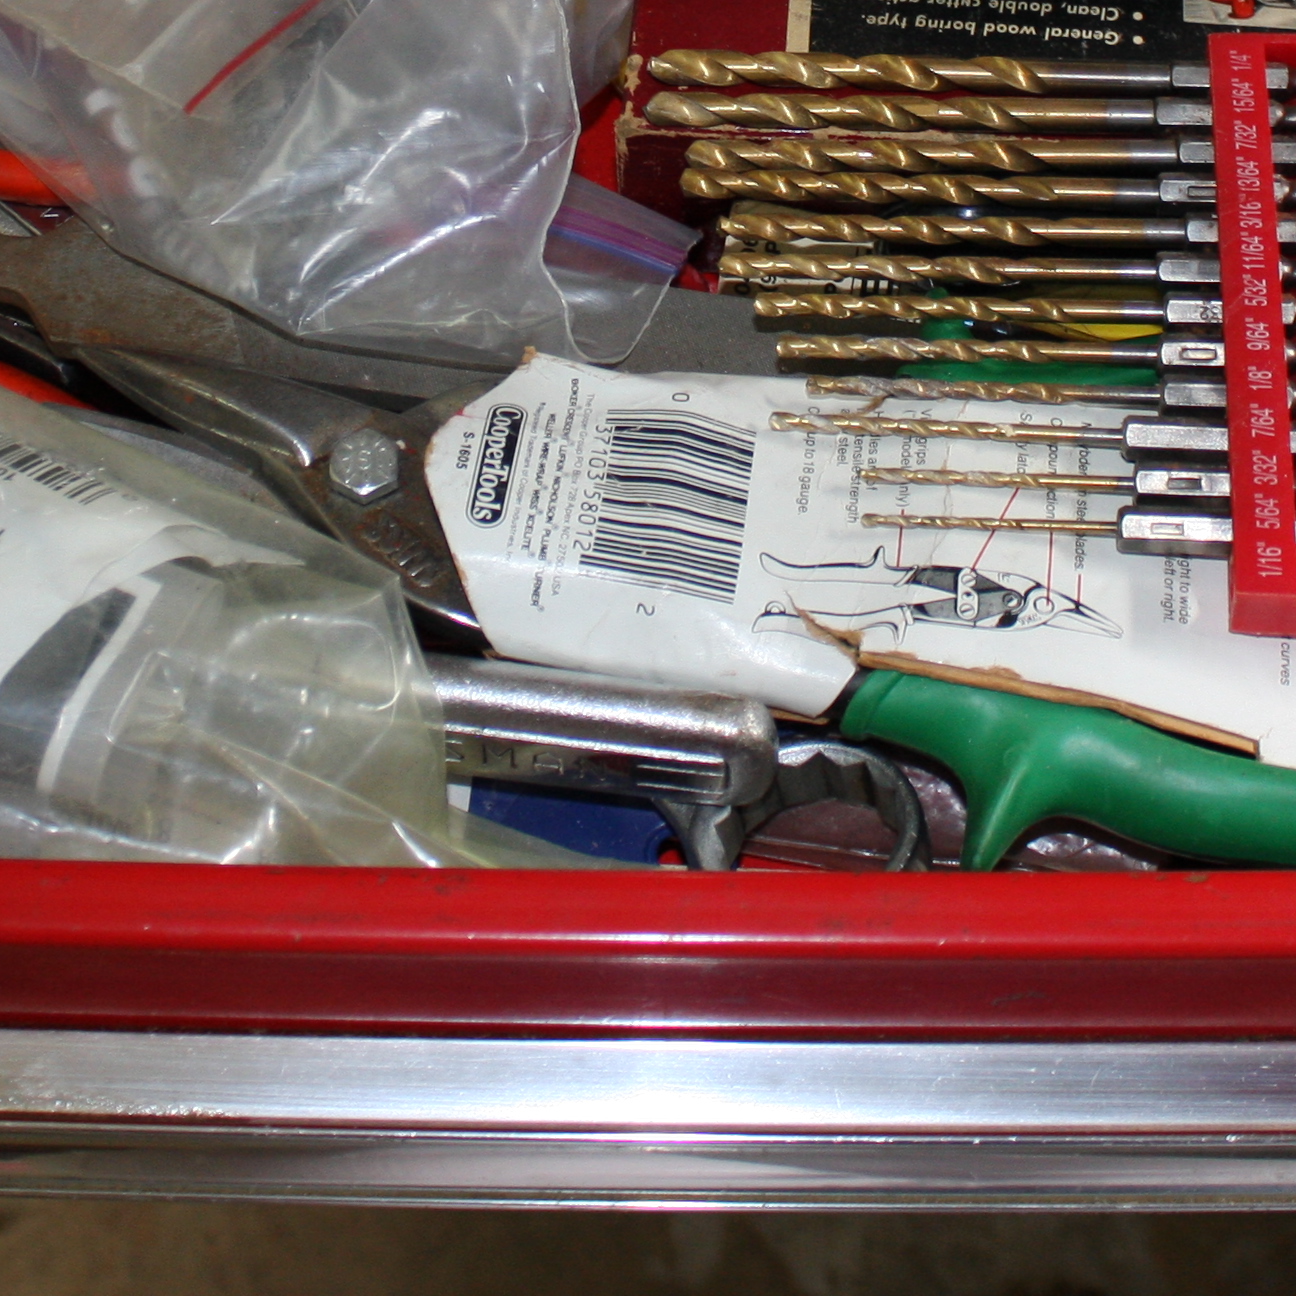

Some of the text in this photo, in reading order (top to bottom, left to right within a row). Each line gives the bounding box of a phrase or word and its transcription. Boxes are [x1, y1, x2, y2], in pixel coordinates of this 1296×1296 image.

[860, 13, 1120, 46] General wood boring type.
[1060, 2, 1120, 22] Clean,
[1228, 49, 1252, 72] 1/4"
[1231, 76, 1255, 114] 15/64"
[1234, 119, 1257, 151] 7/32"
[1240, 231, 1266, 269] 11/64"
[1243, 273, 1268, 307] 5/32"
[1244, 317, 1271, 351] 9/64"
[1247, 365, 1273, 391] 1/8"
[1250, 402, 1276, 438] 7/64"
[455, 431, 475, 471] S-1605
[472, 408, 521, 522] CooperTools
[587, 424, 613, 482] 37103
[803, 461, 816, 475] 18
[805, 448, 814, 459] to
[1252, 449, 1279, 486] 3/32"
[845, 474, 863, 524] strength
[1255, 493, 1281, 530] 5/64"
[572, 489, 602, 553] 58012
[1257, 541, 1283, 578] 1/16"
[1278, 645, 1292, 687] curves
